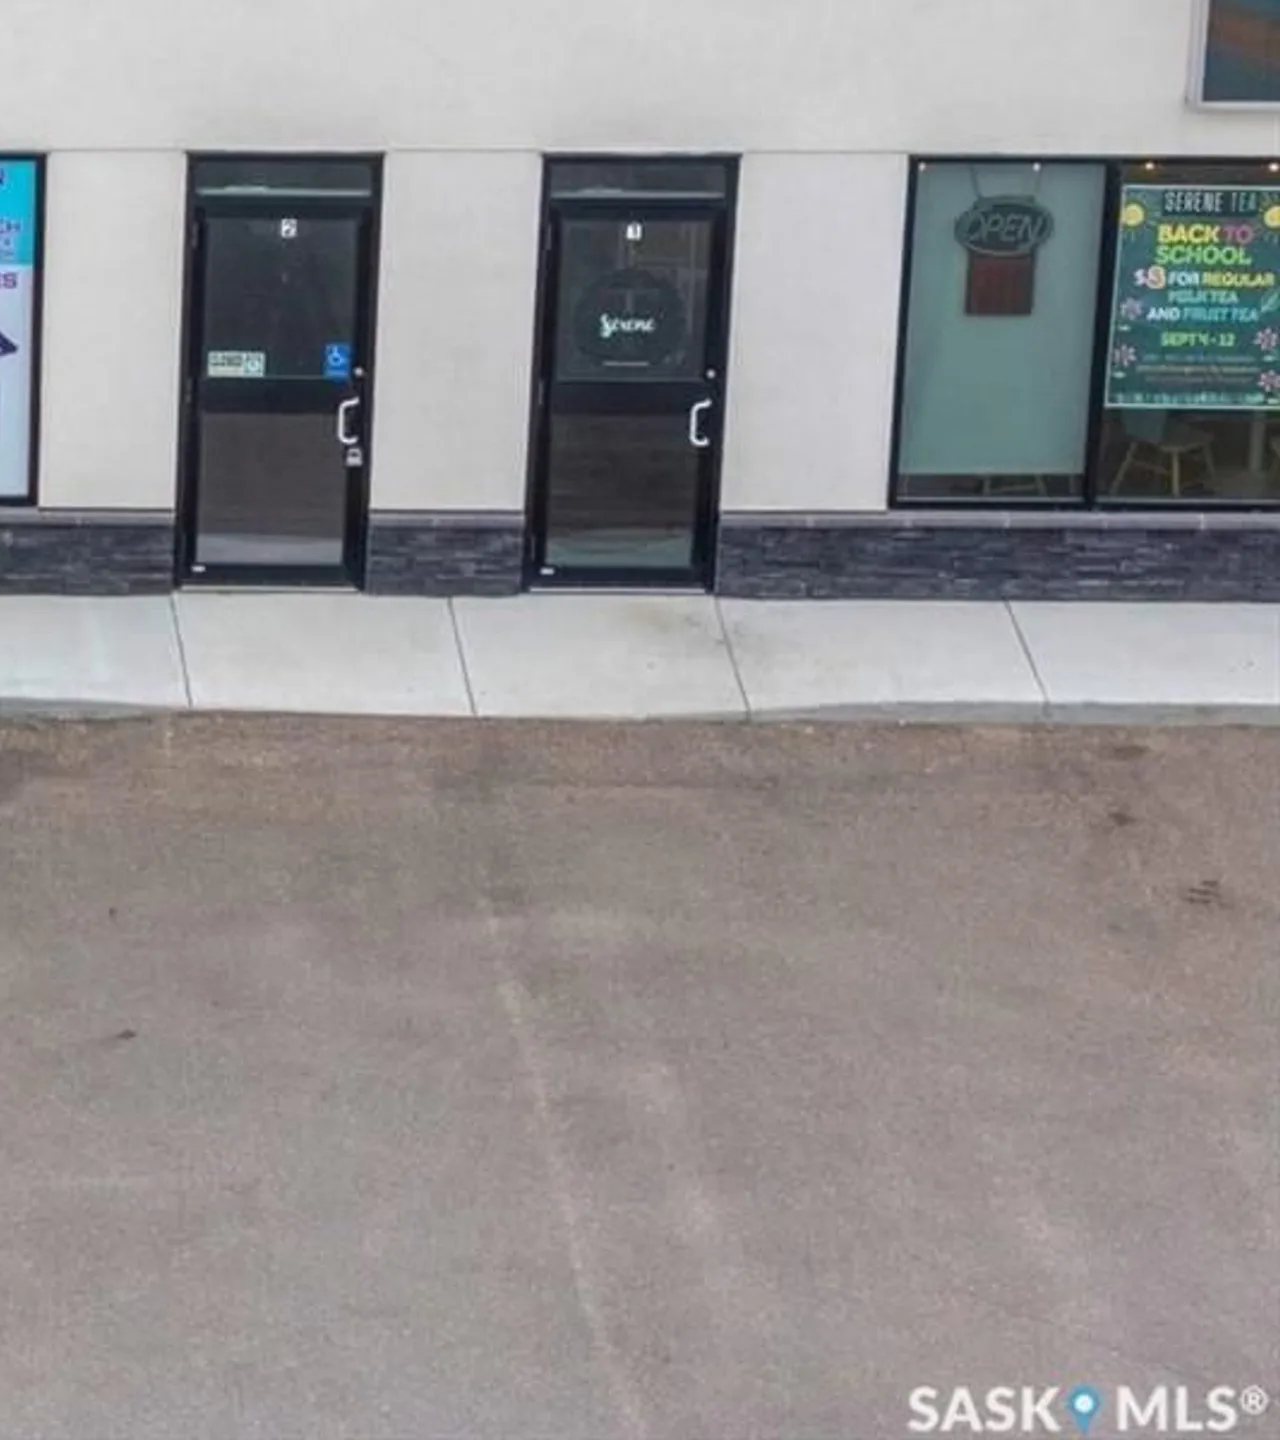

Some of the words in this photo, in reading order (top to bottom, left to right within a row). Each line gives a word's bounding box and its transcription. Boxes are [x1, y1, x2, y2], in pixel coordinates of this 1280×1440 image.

[1164, 191, 1224, 212] SERENE
[1230, 191, 1258, 212] TEA
[964, 209, 1044, 245] OPEN
[1157, 223, 1220, 244] BACK
[1223, 225, 1253, 245] TO
[1155, 245, 1253, 265] SCHOOL
[1168, 271, 1200, 285] FOR
[1201, 271, 1275, 287] REGULAR
[1146, 307, 1182, 321] AND
[600, 313, 655, 338] Serene
